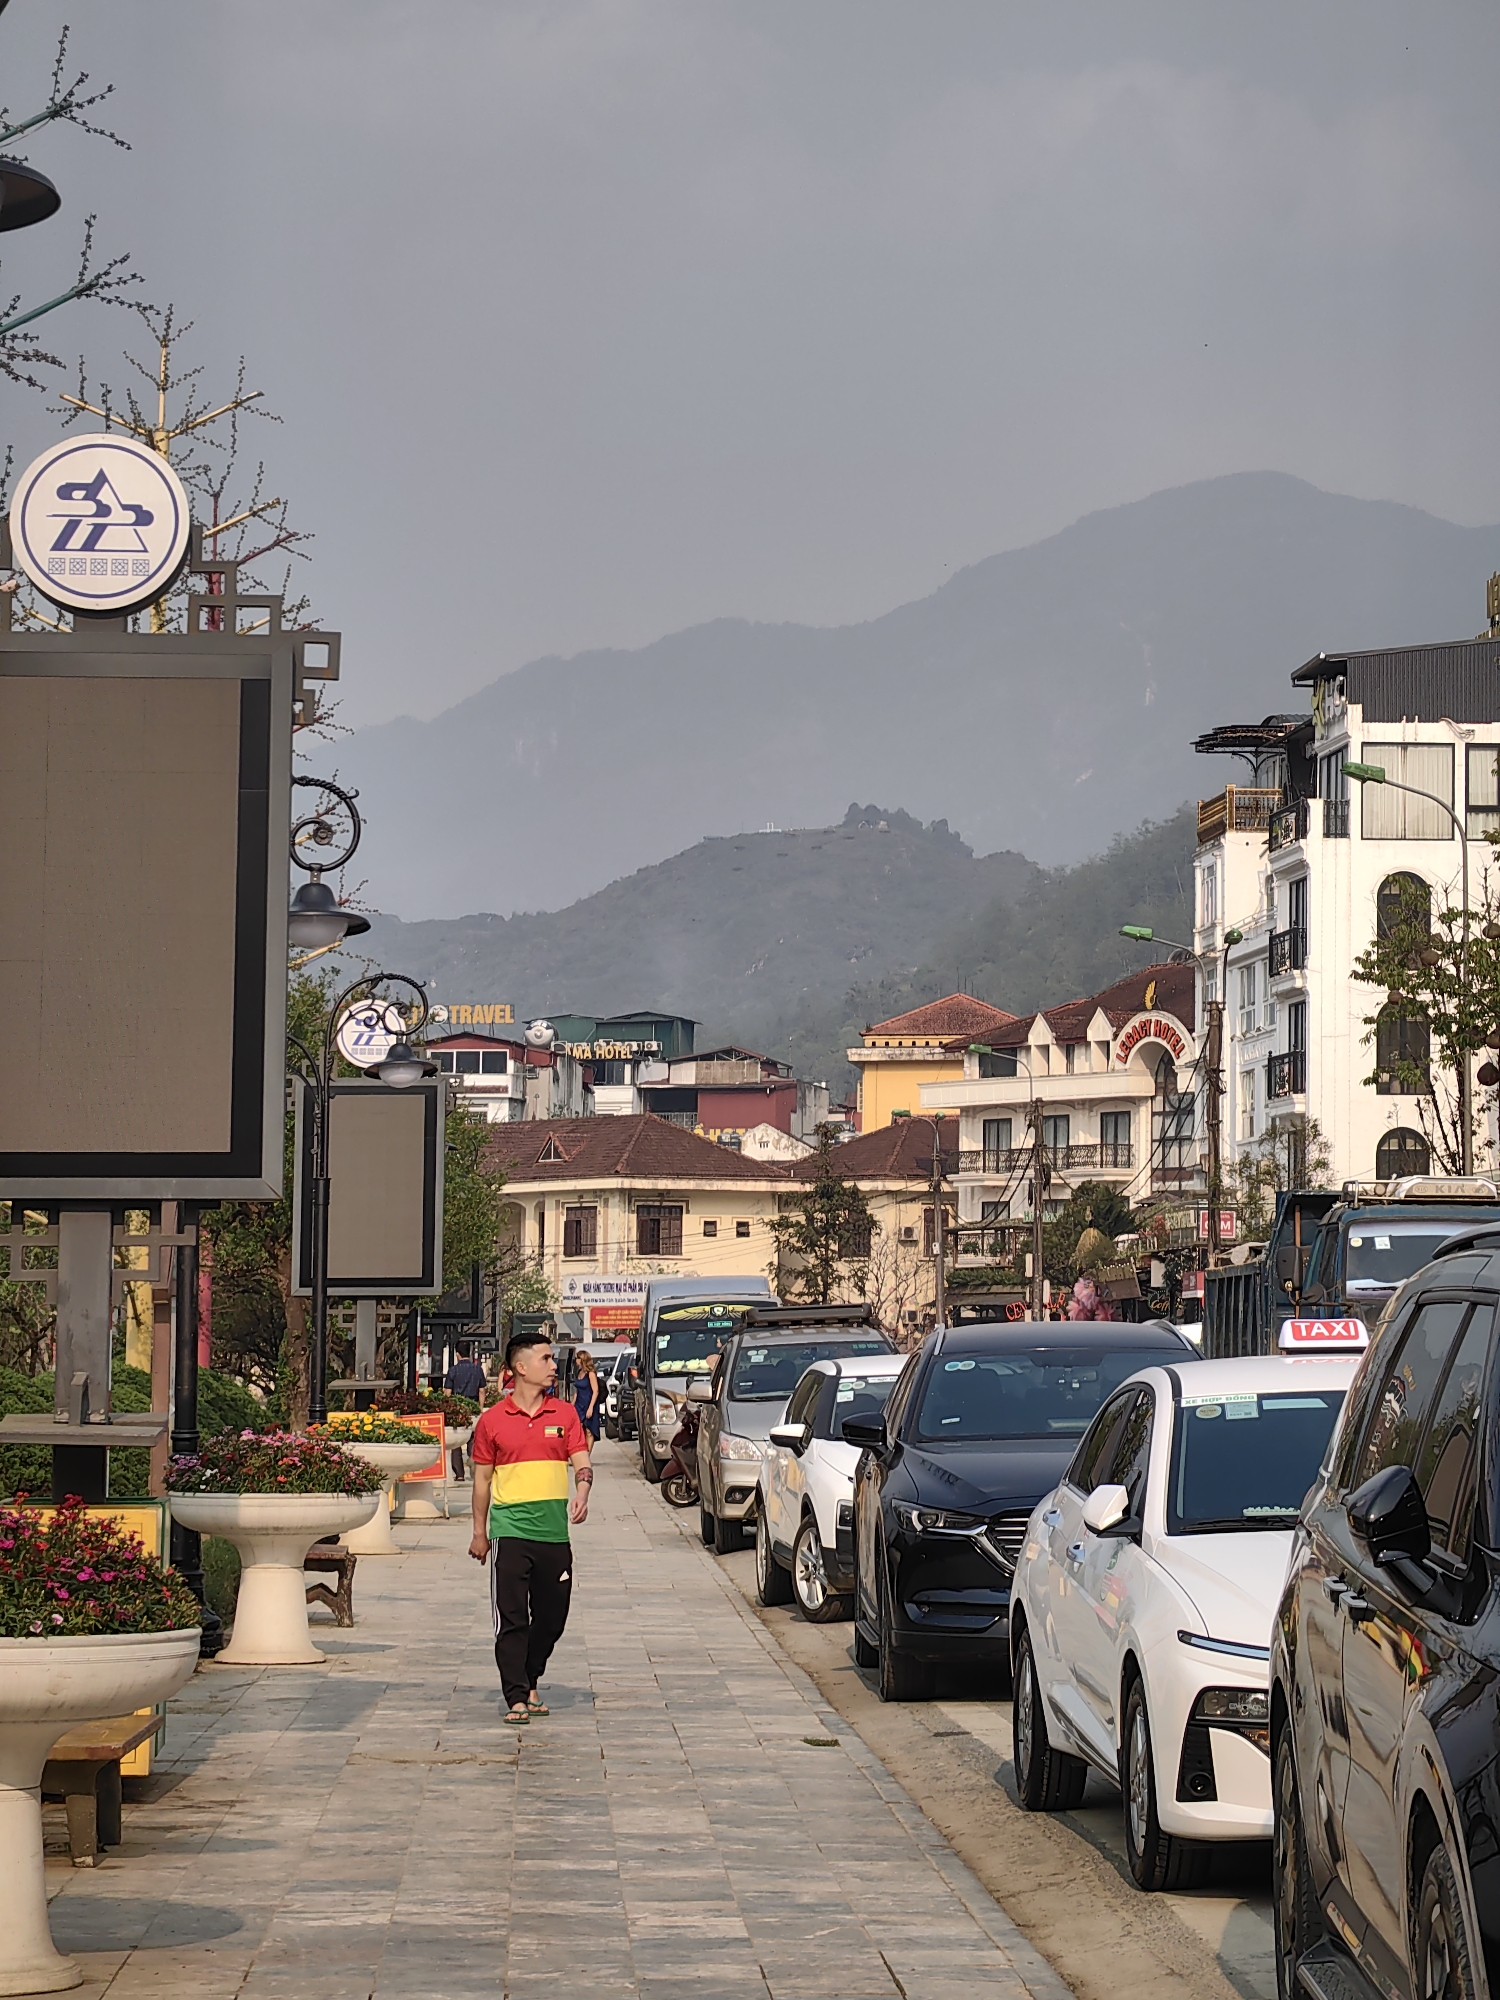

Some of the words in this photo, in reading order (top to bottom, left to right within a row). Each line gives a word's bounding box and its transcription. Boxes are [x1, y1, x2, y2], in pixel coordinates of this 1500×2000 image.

[449, 1004, 515, 1024] TRAVEL
[1116, 1018, 1152, 1065] LEGACY
[1153, 1018, 1187, 1060] HOTEL
[596, 1045, 633, 1059] HOTEL
[1435, 1184, 1466, 1194] KIA
[1294, 1321, 1356, 1338] TAXI
